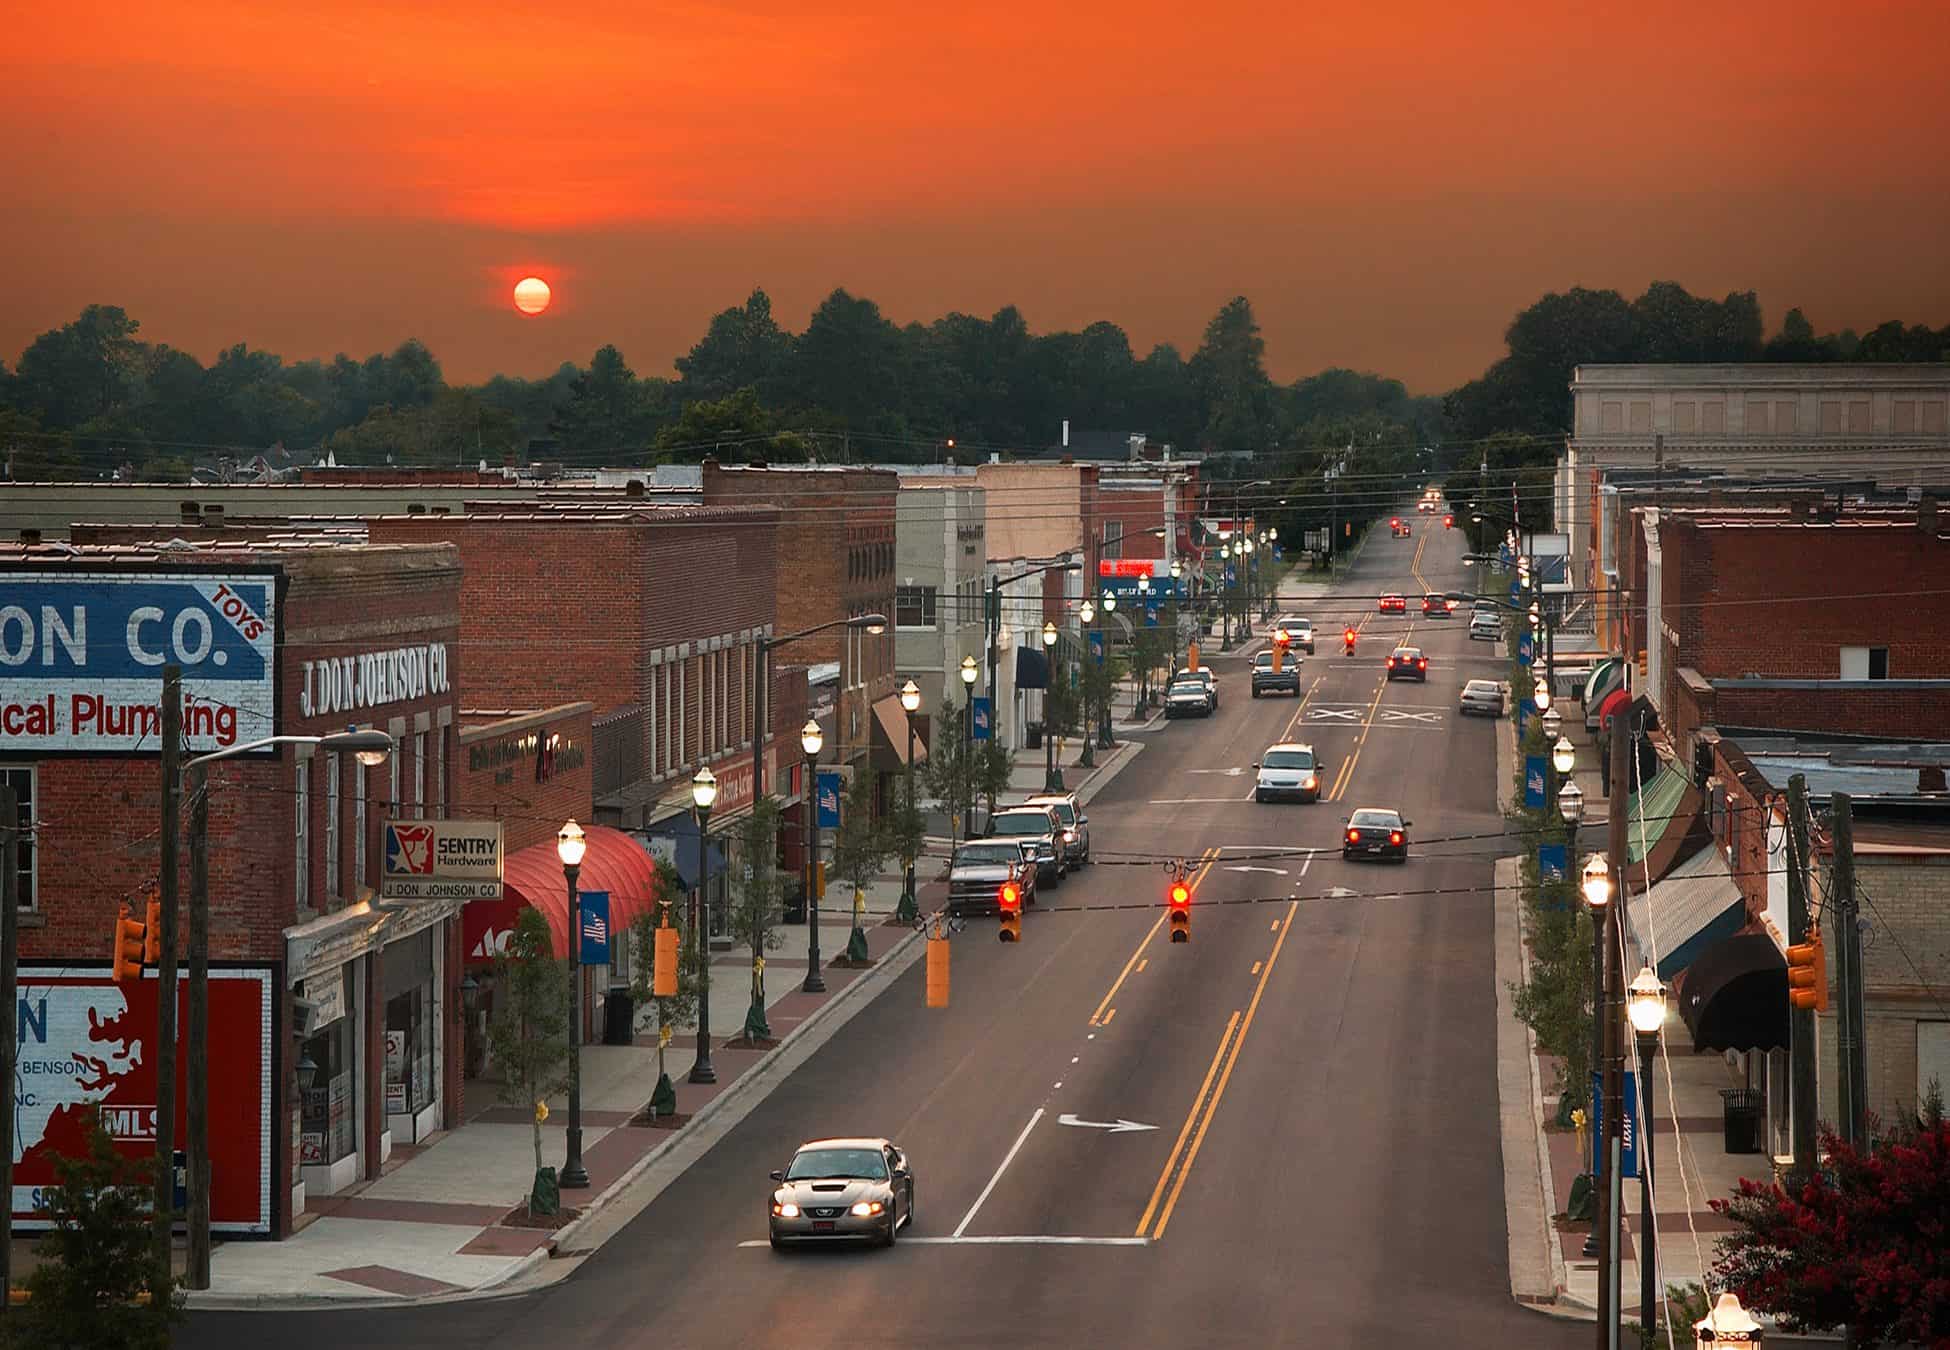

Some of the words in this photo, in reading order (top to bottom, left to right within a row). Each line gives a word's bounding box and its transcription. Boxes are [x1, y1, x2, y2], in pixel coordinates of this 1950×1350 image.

[212, 583, 266, 641] TOYS
[126, 606, 228, 667] CO.
[316, 656, 355, 715] DON
[355, 646, 427, 708] JOHNSON
[428, 642, 450, 696] CO.
[0, 694, 55, 736] cal
[71, 694, 237, 746] Pluming
[438, 838, 497, 855] SENTRY
[438, 855, 496, 866] Hardware
[386, 884, 393, 896] J
[396, 884, 419, 896] DON
[426, 884, 475, 896] JOHNSON
[479, 884, 496, 896] CO
[471, 928, 515, 957] AC
[22, 1061, 87, 1074] BENSON
[15, 1093, 40, 1106] NC.
